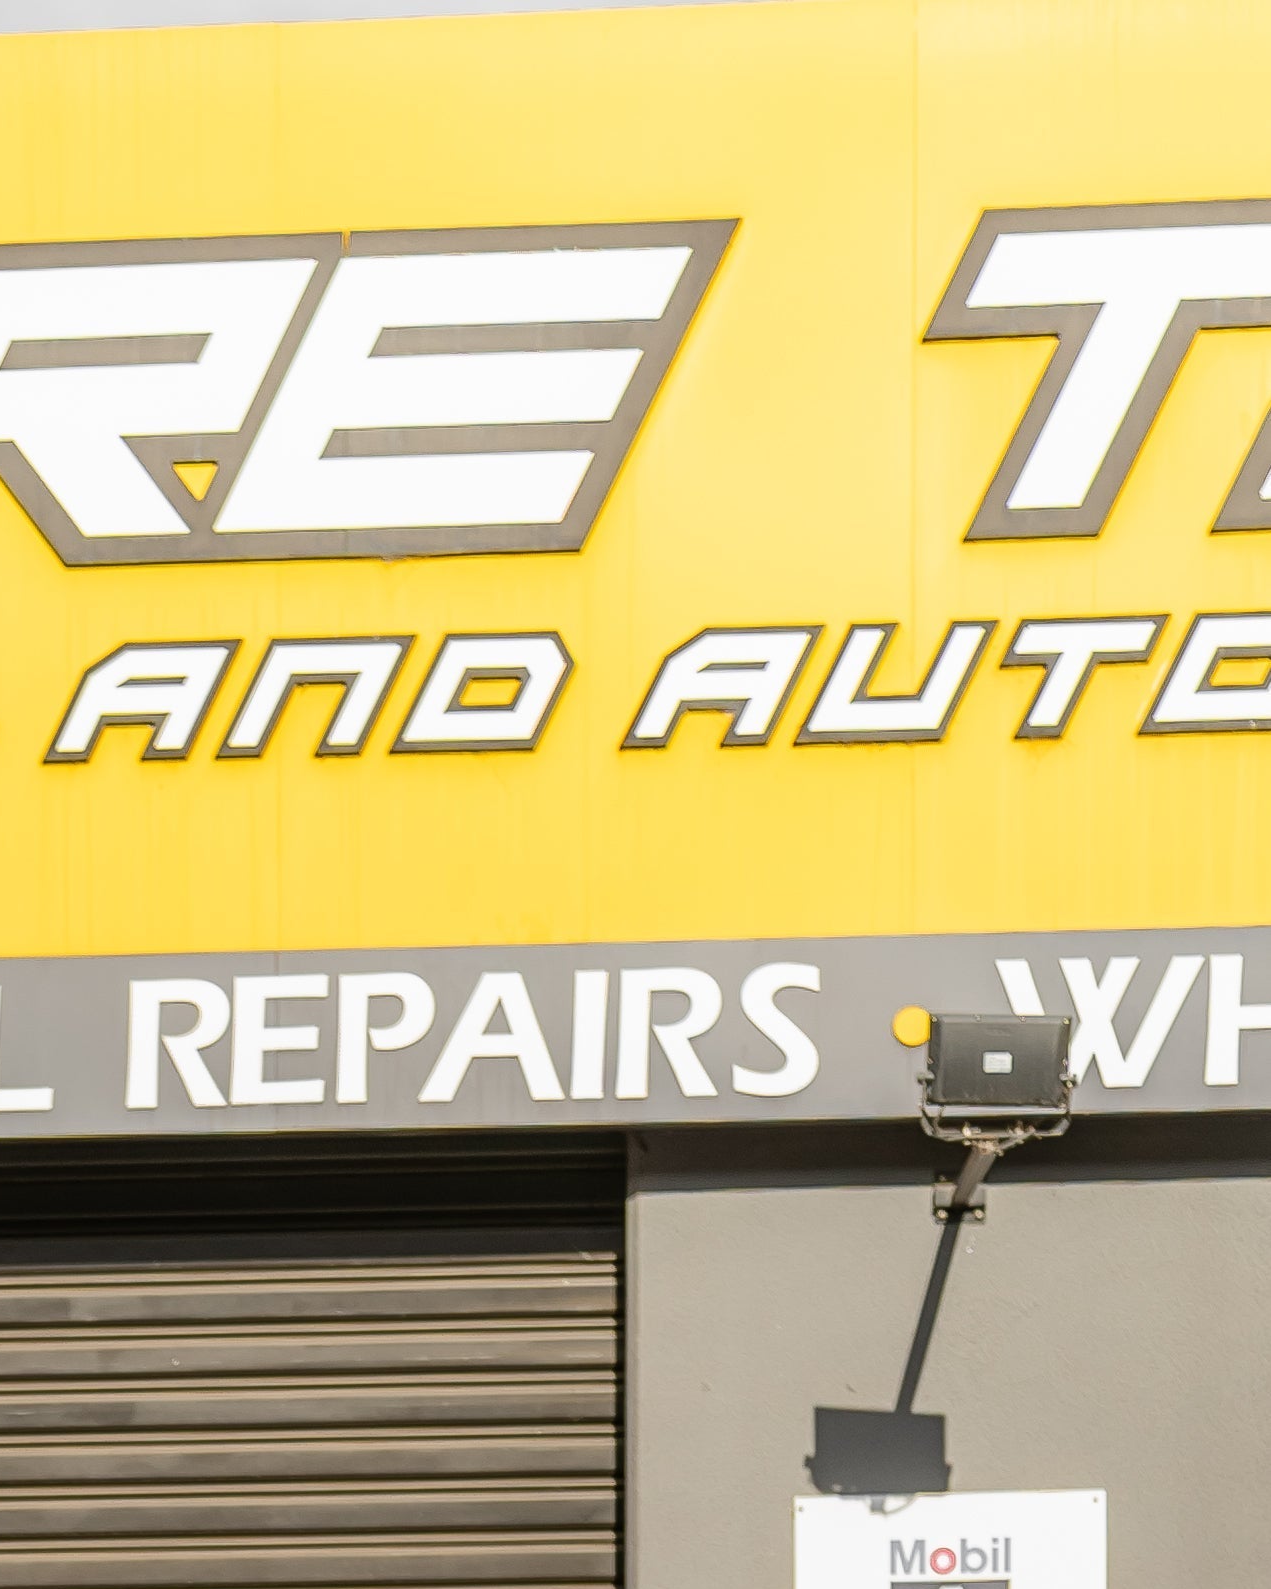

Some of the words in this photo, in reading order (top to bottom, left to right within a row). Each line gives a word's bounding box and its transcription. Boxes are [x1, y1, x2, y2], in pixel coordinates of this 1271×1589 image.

[922, 198, 1271, 542] T
[42, 630, 574, 764] AND
[620, 611, 1271, 751] AUTO
[124, 962, 822, 1111] REPAIRS
[890, 1537, 1011, 1575] Mobil
